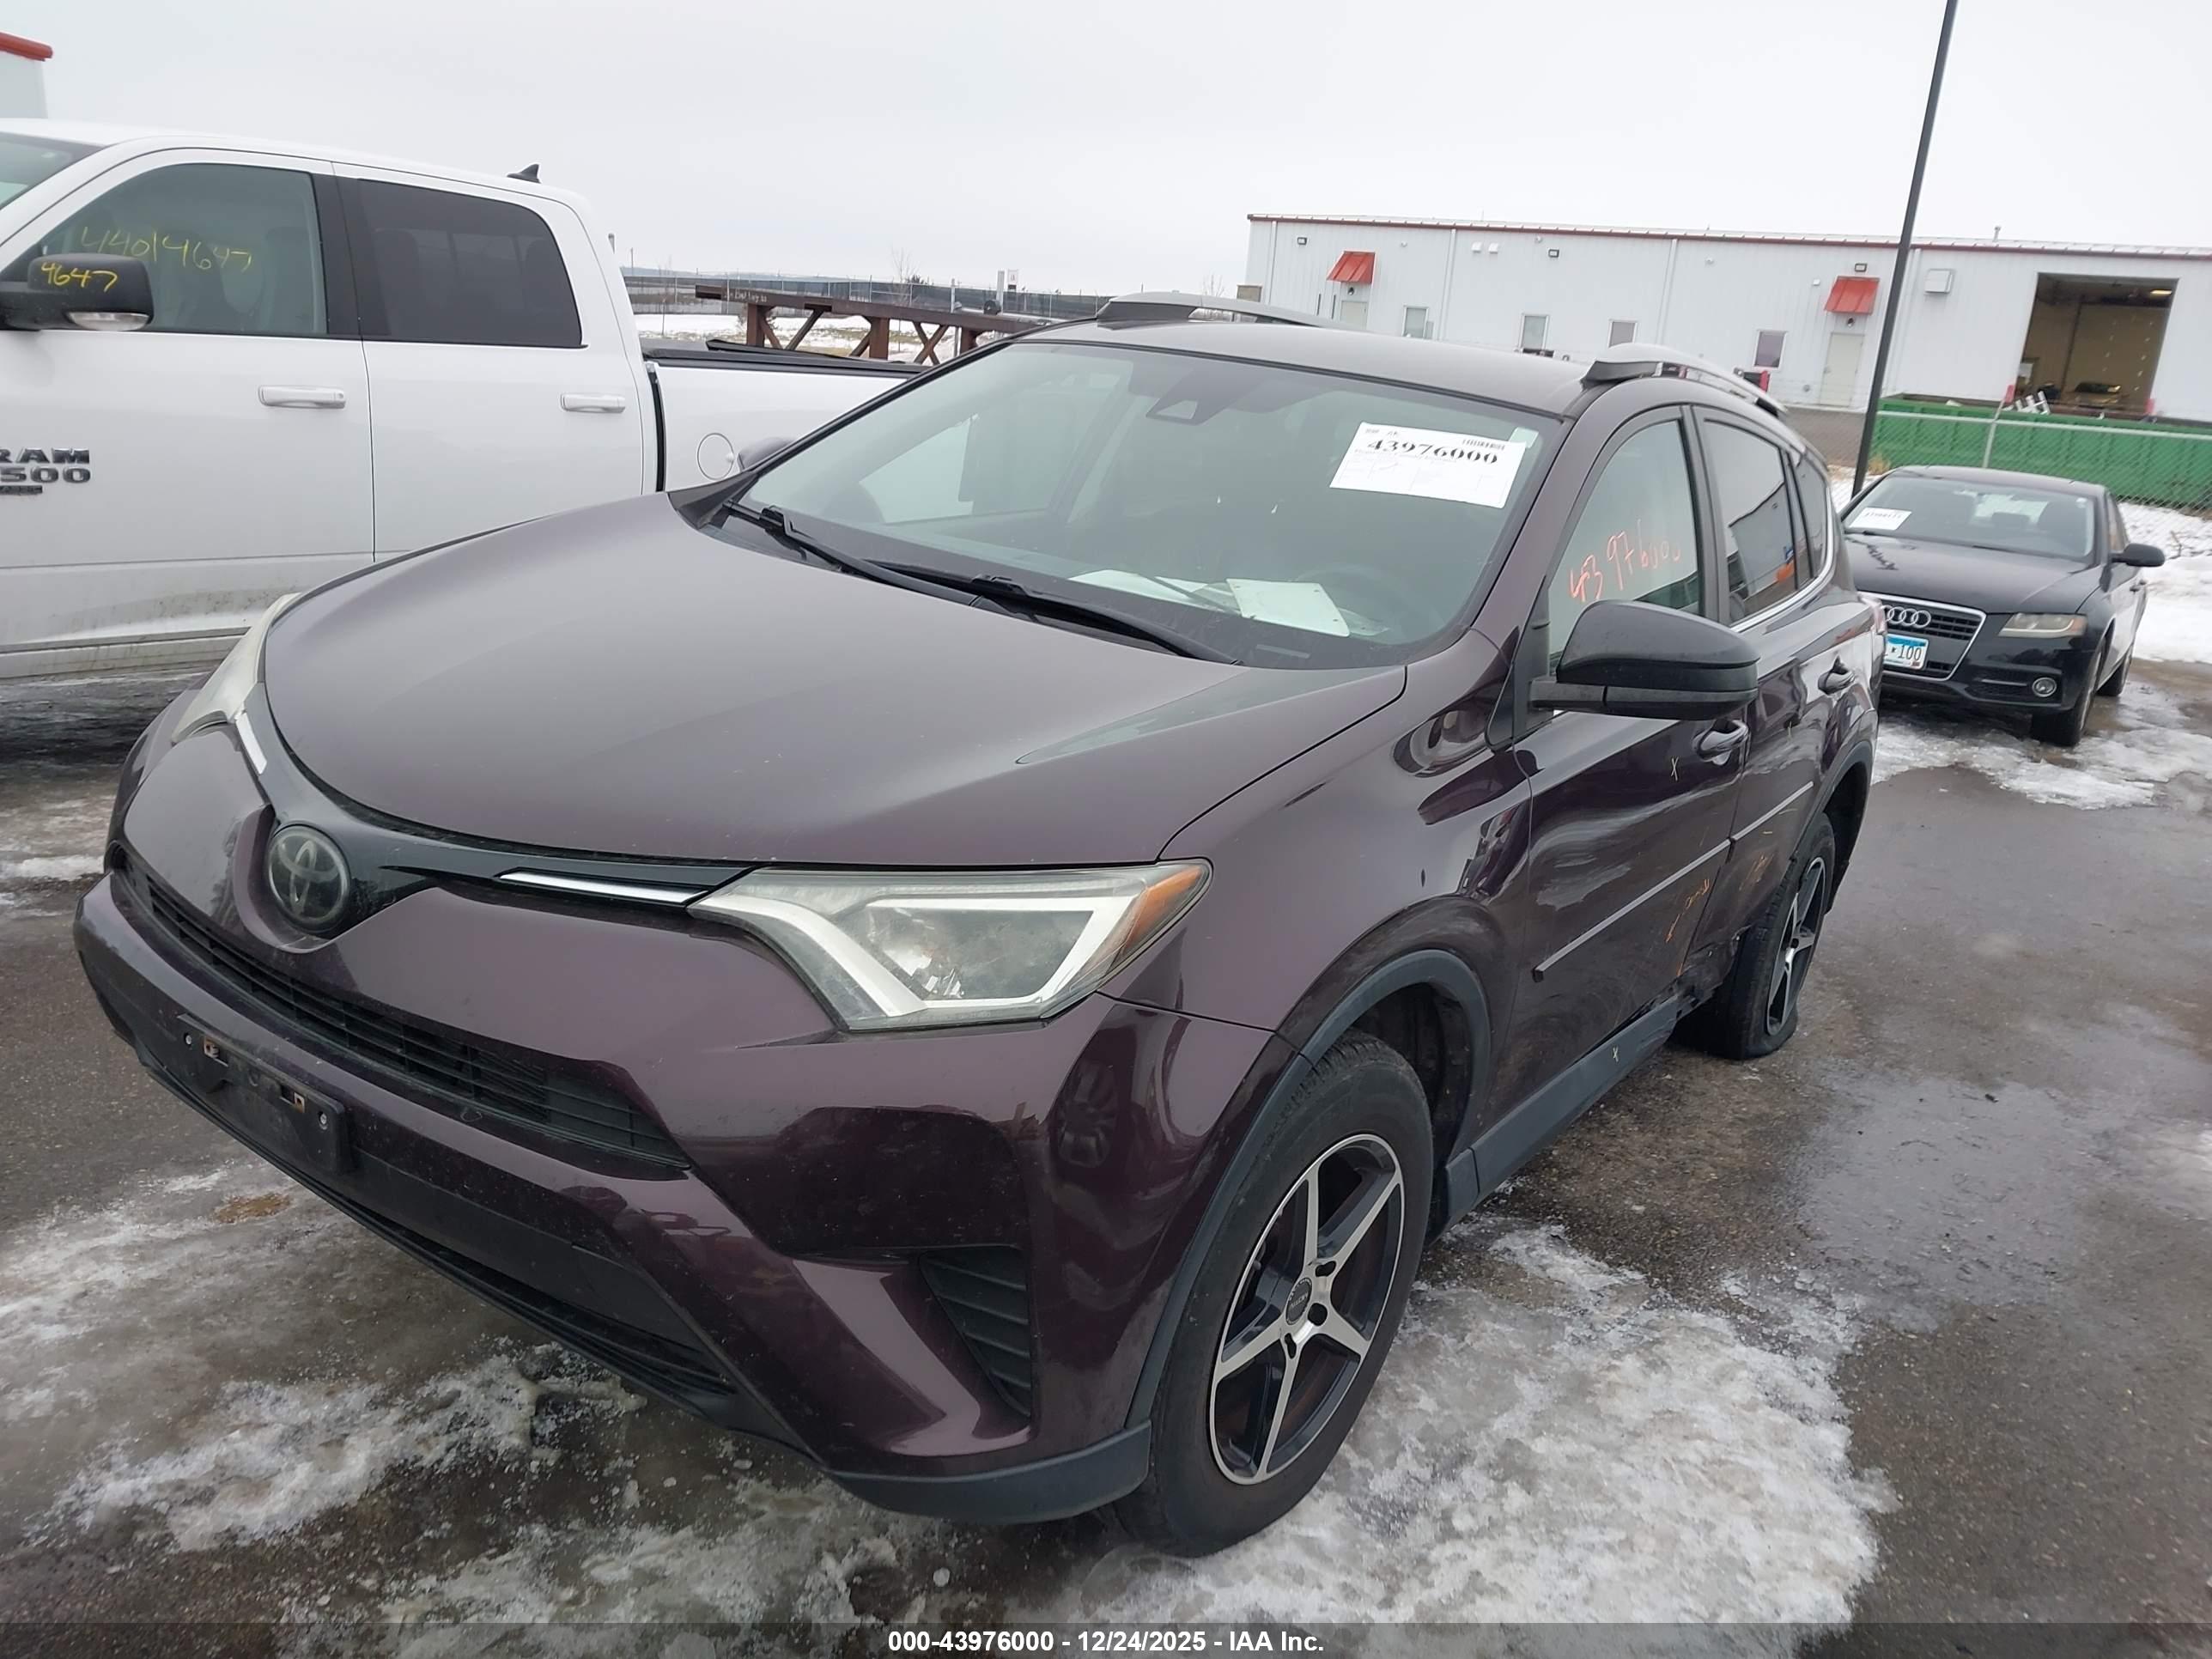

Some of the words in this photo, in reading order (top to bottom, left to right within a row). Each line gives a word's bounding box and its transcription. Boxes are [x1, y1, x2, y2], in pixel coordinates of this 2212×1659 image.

[81, 226, 252, 273] 44014647
[40, 260, 118, 293] 4647
[1368, 439, 1498, 465] 43976000
